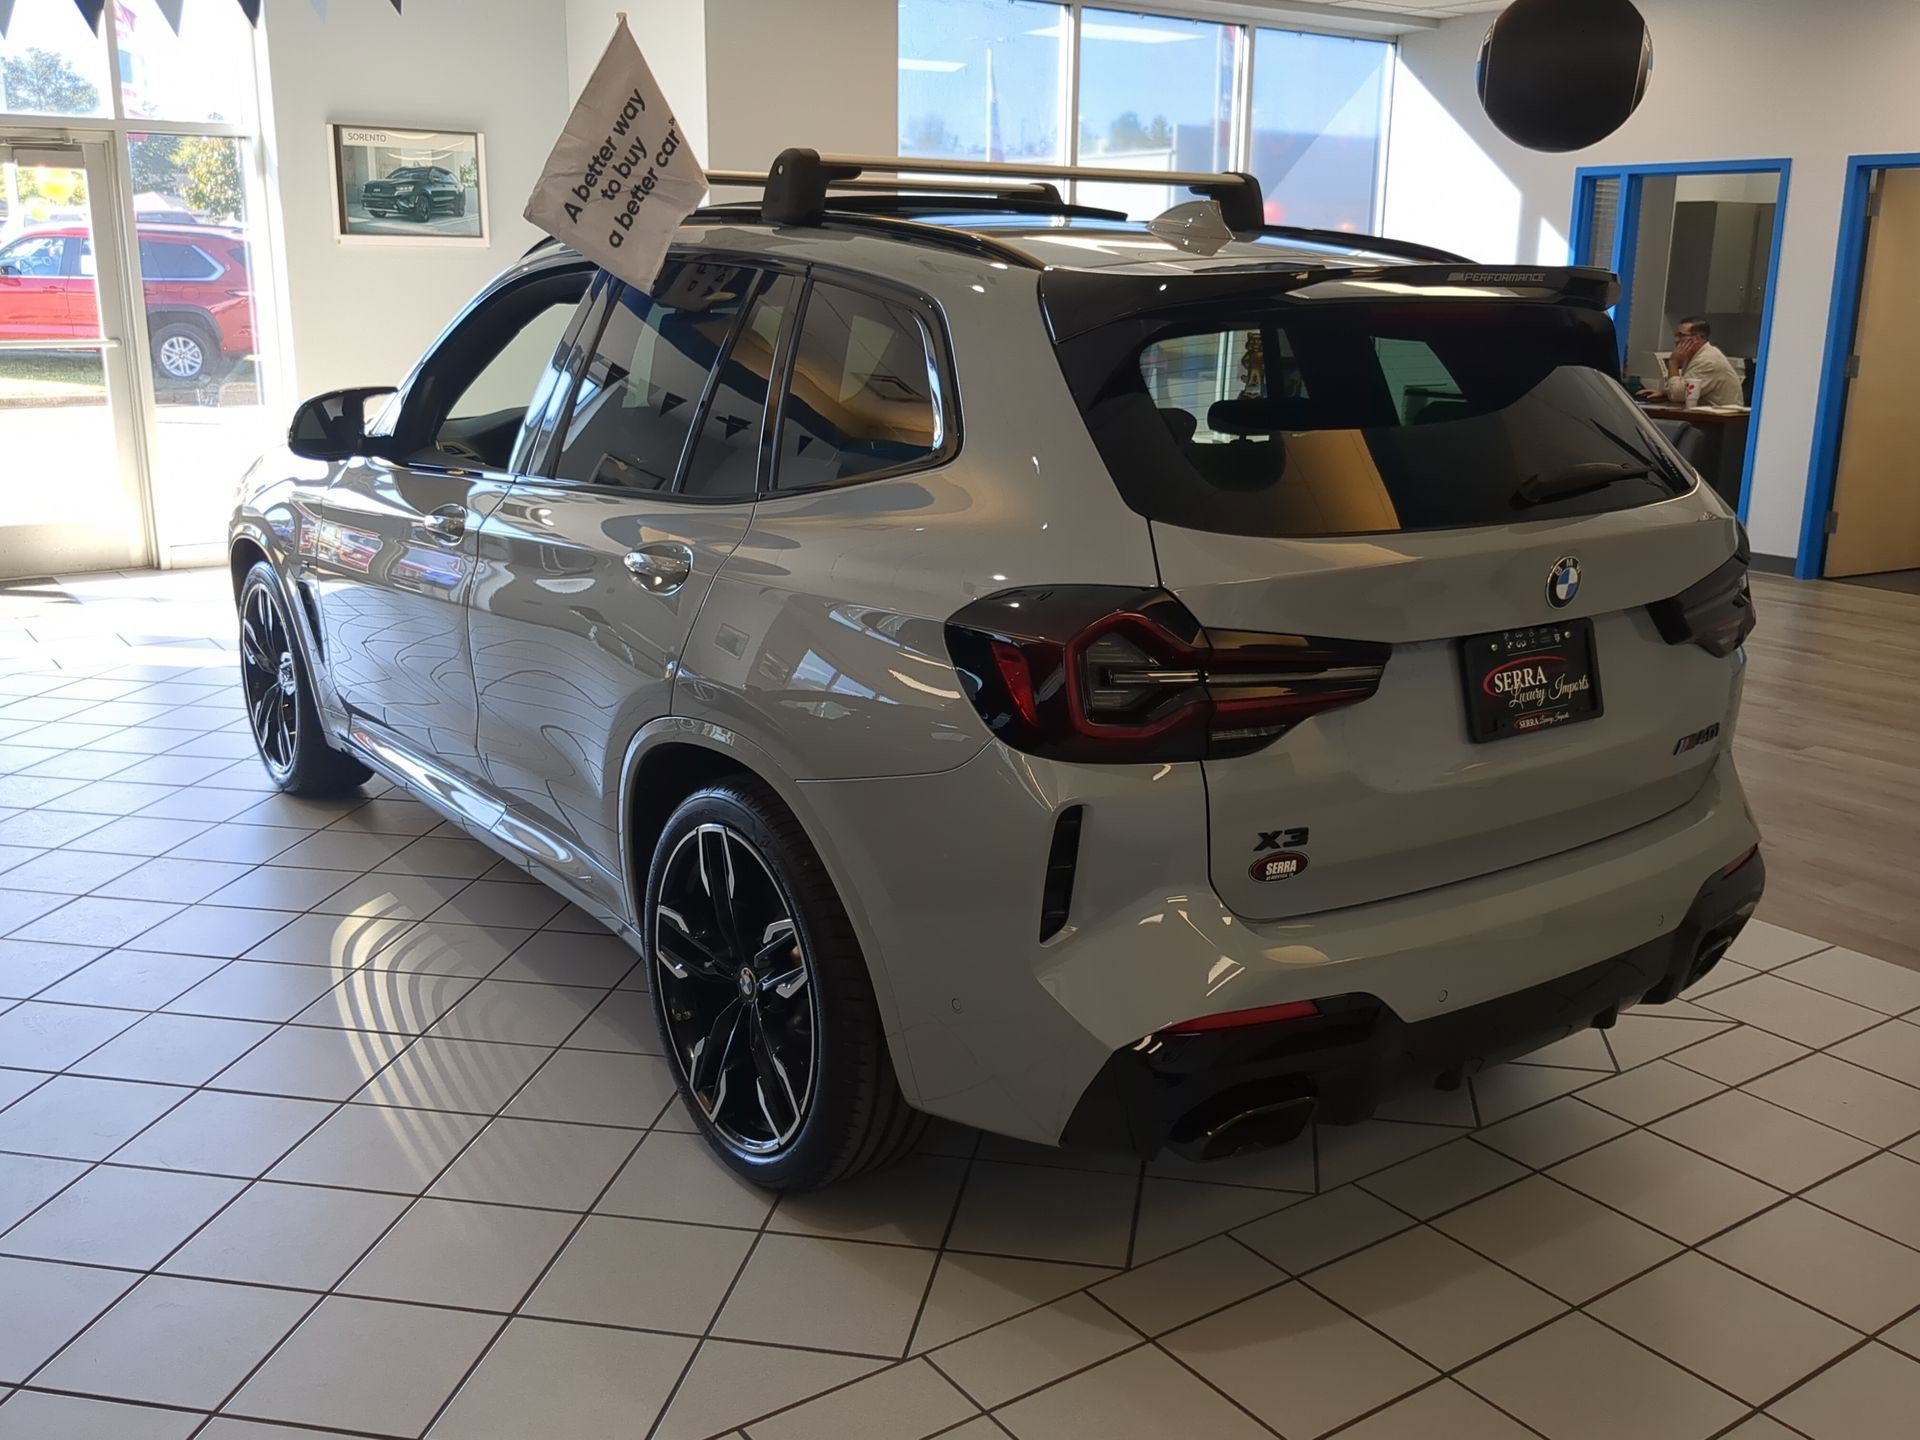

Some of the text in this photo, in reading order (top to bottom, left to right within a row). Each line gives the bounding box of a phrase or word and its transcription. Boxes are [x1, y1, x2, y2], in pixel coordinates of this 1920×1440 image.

[347, 132, 387, 143] SORENTO
[563, 88, 646, 224] A better way
[601, 136, 647, 201] to buy
[614, 167, 659, 231] better
[608, 229, 624, 248] a
[1494, 665, 1548, 693] SERRA
[1508, 673, 1589, 710] Luxury Imports
[1253, 827, 1309, 851] X3
[1266, 859, 1297, 876] SERRA
